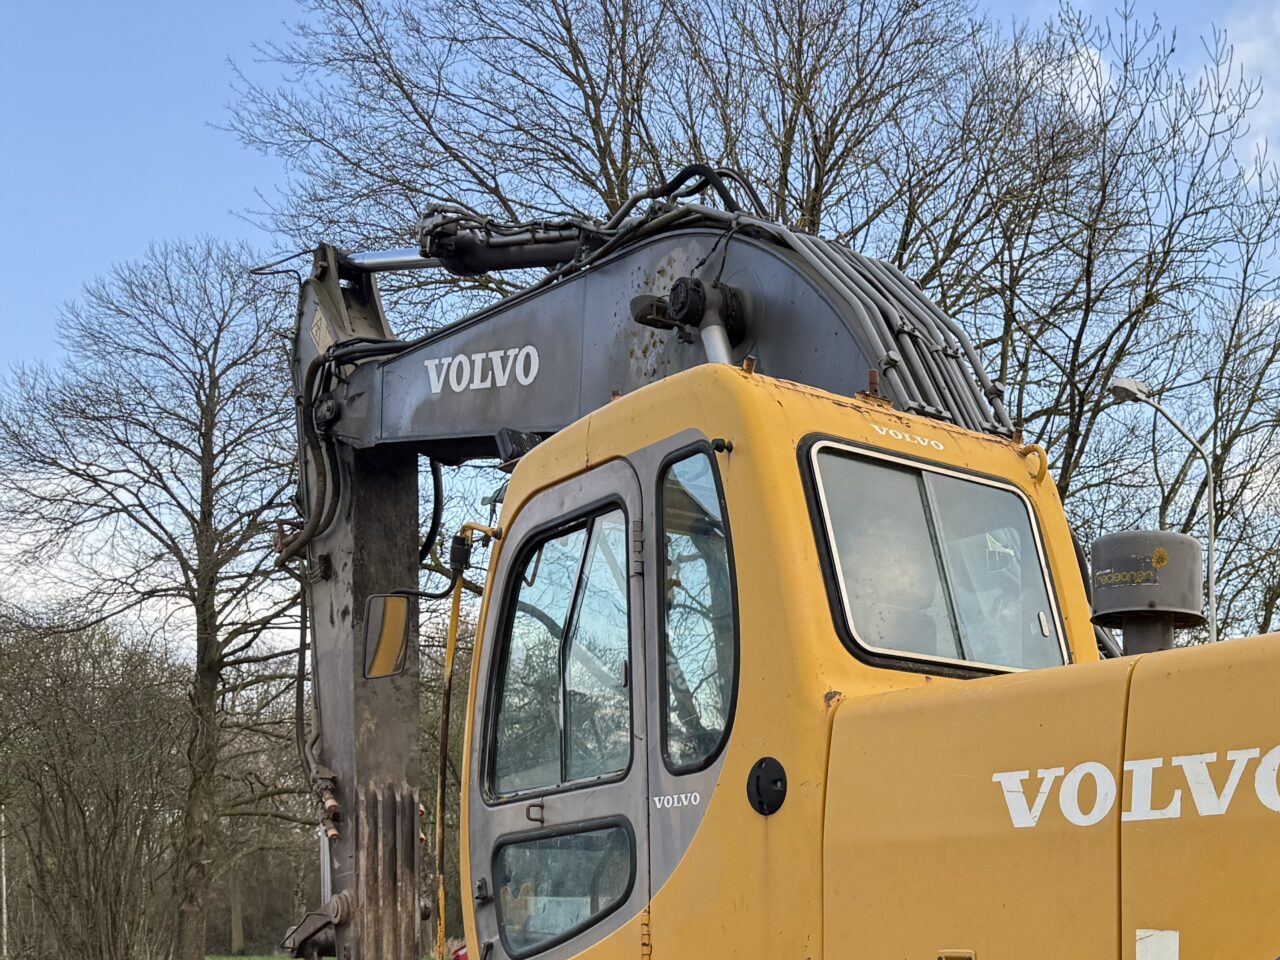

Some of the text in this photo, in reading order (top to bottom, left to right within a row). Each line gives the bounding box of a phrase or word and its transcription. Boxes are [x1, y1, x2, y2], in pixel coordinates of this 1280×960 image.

[424, 345, 540, 394] VOLVO
[870, 423, 944, 451] VOLVO
[652, 792, 700, 809] VOLVO
